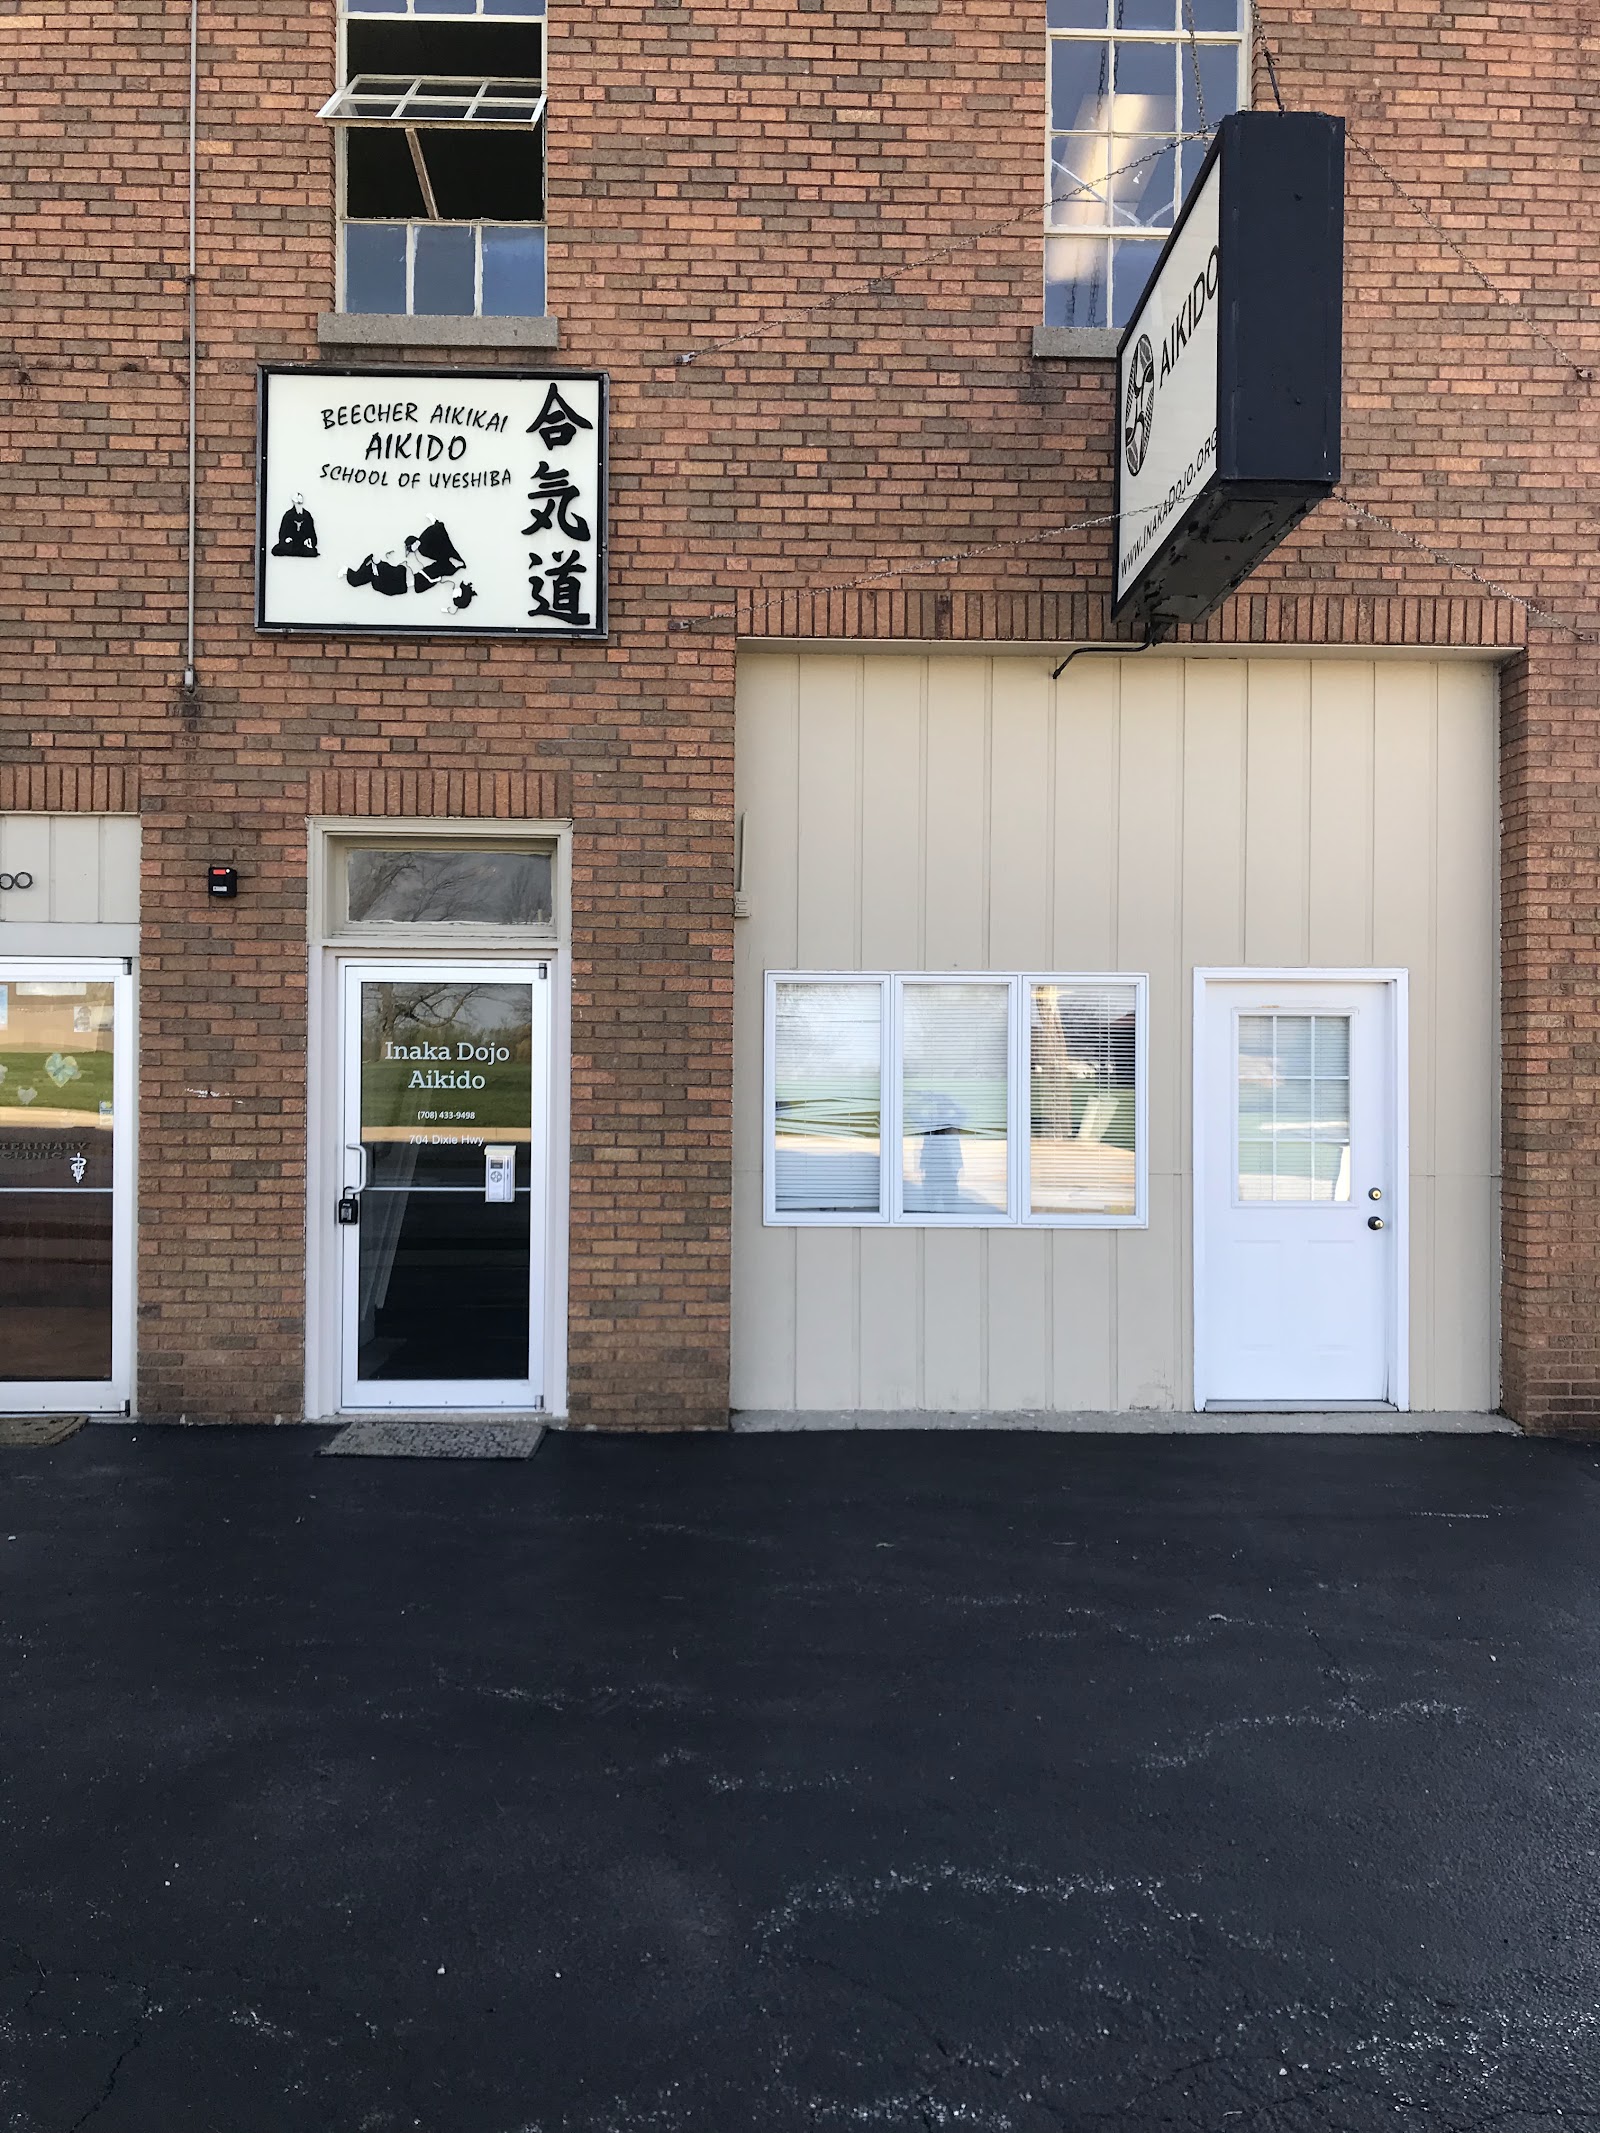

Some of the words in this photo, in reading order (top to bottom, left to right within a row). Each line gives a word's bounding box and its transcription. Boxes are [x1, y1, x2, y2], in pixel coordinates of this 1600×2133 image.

[1159, 245, 1219, 390] AIKIDO
[321, 403, 418, 430] BEECHER
[429, 404, 509, 433] AIKIKAI
[365, 432, 467, 461] AIKIDO
[320, 464, 388, 486] SCHOOL
[398, 472, 420, 489] OF
[429, 468, 512, 489] UYESHIBA
[520, 382, 595, 626] 合気道
[385, 1041, 451, 1061] Inaka
[457, 1042, 510, 1066] Dojo
[408, 1070, 486, 1090] Aikido
[417, 1110, 438, 1120] (708)
[439, 1111, 476, 1120] 433-9498
[409, 1134, 429, 1145] 704
[432, 1134, 458, 1145] Dixie
[461, 1135, 485, 1147] Hwy
[1, 1151, 63, 1160] CLINIC
